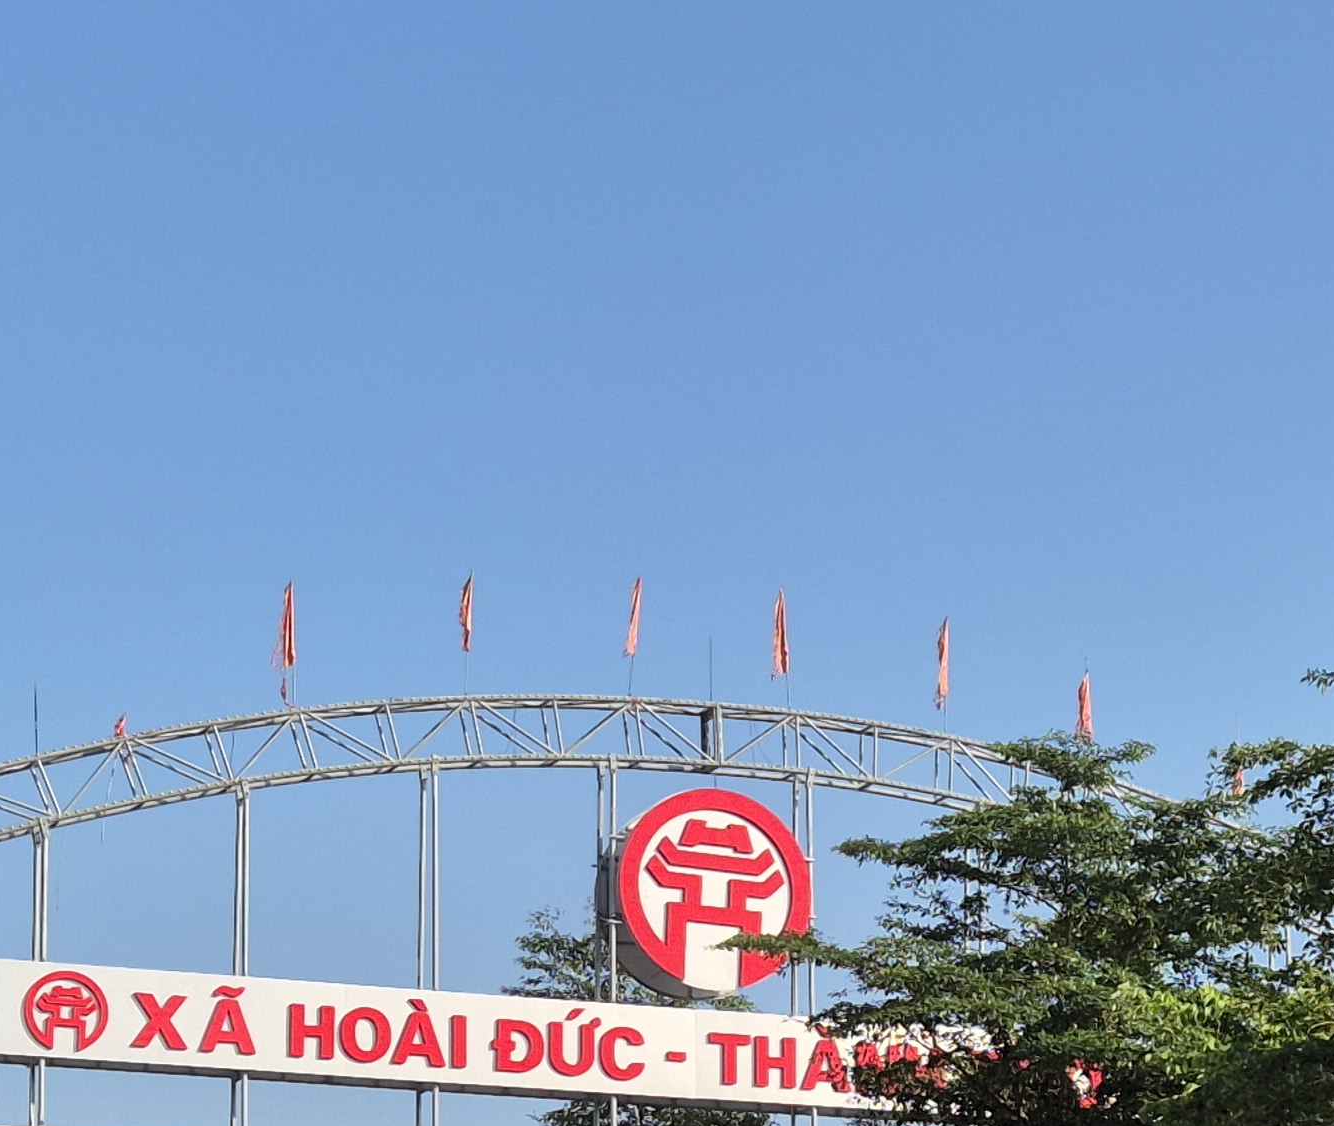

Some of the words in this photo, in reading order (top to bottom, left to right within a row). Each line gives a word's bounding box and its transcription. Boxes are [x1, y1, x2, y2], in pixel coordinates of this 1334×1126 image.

[129, 986, 256, 1056] XÃ
[287, 998, 468, 1069] HOÀI
[490, 1007, 646, 1081] ĐỨC
